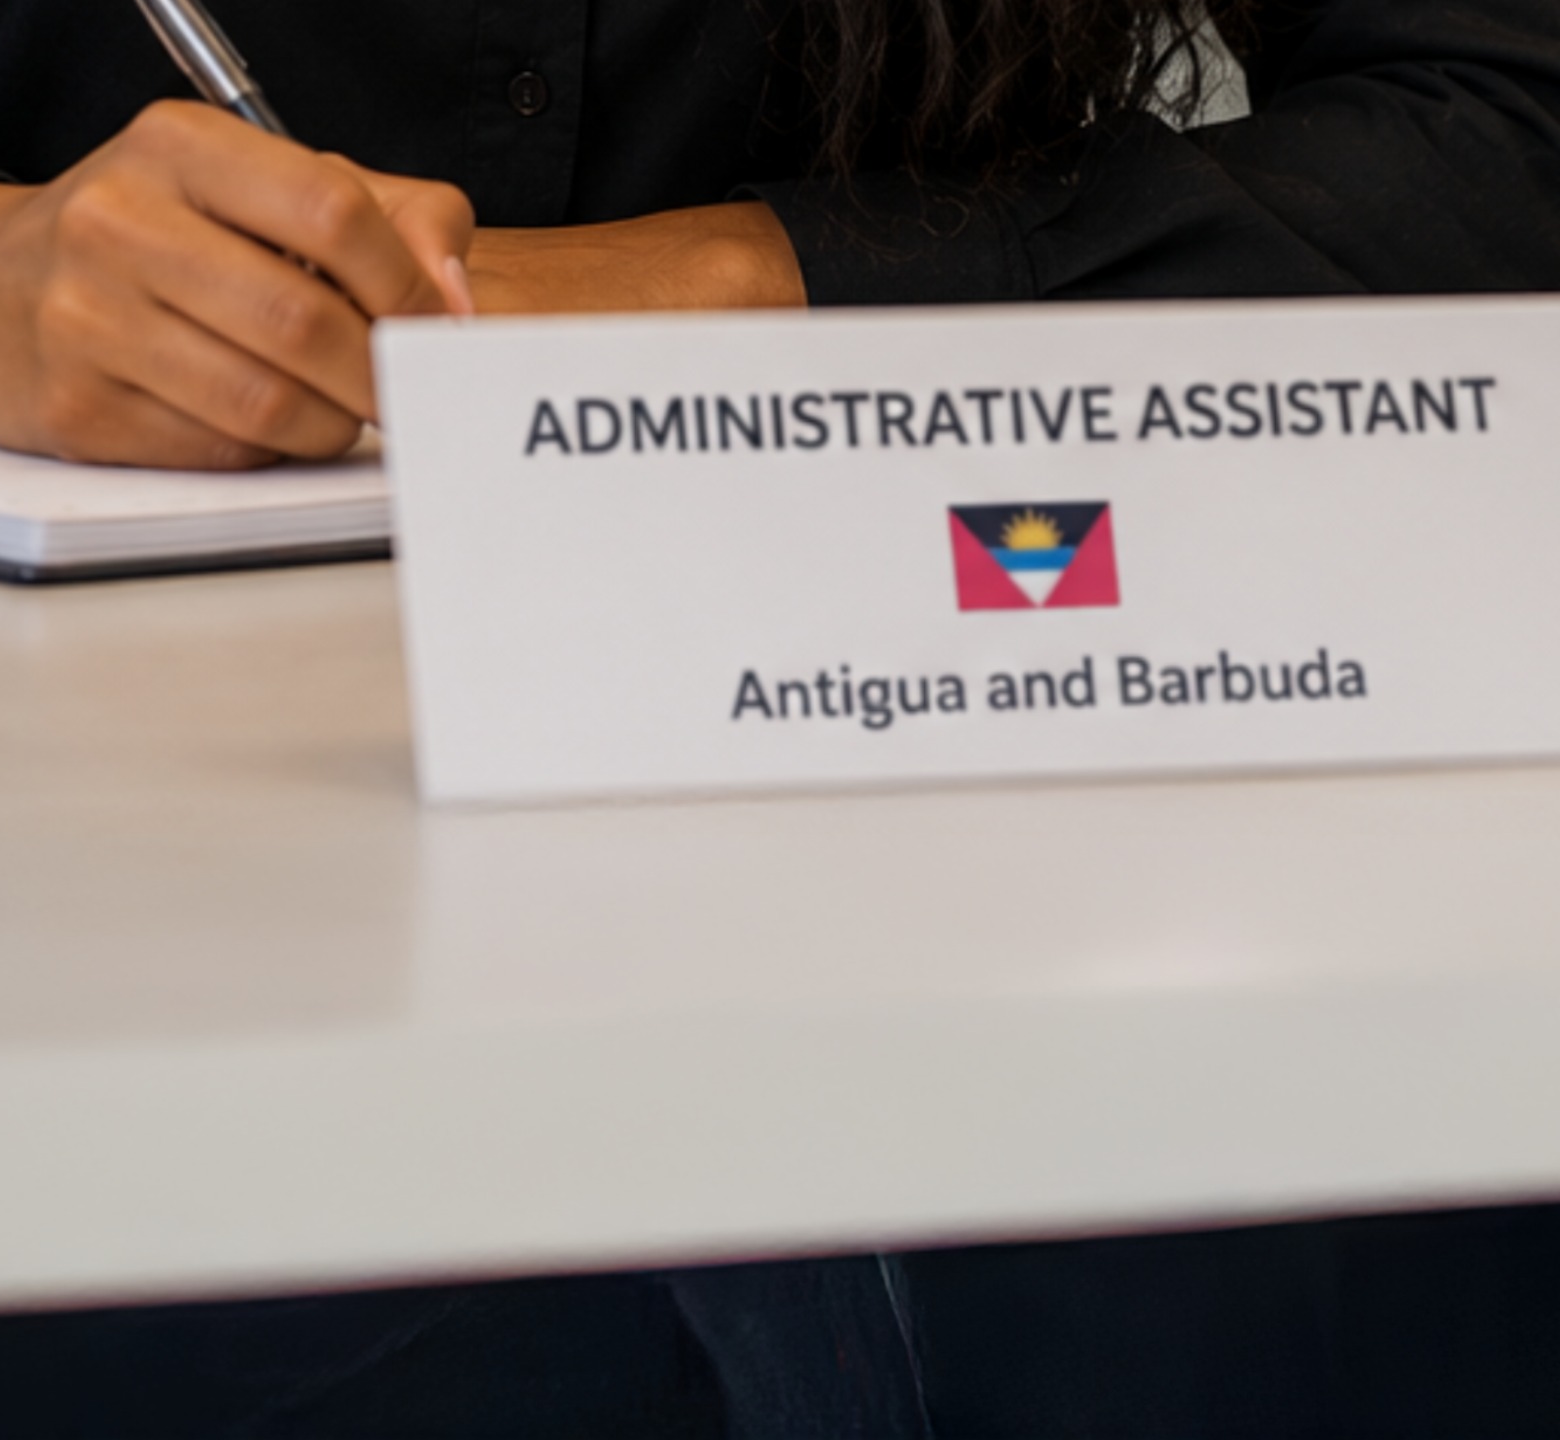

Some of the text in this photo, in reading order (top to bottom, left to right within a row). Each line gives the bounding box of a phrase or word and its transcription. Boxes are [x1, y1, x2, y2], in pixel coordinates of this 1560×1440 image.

[523, 376, 1497, 456] ADMINISTRATIVE ASSISTANT
[730, 647, 1368, 731] Antigua and Barbuda
